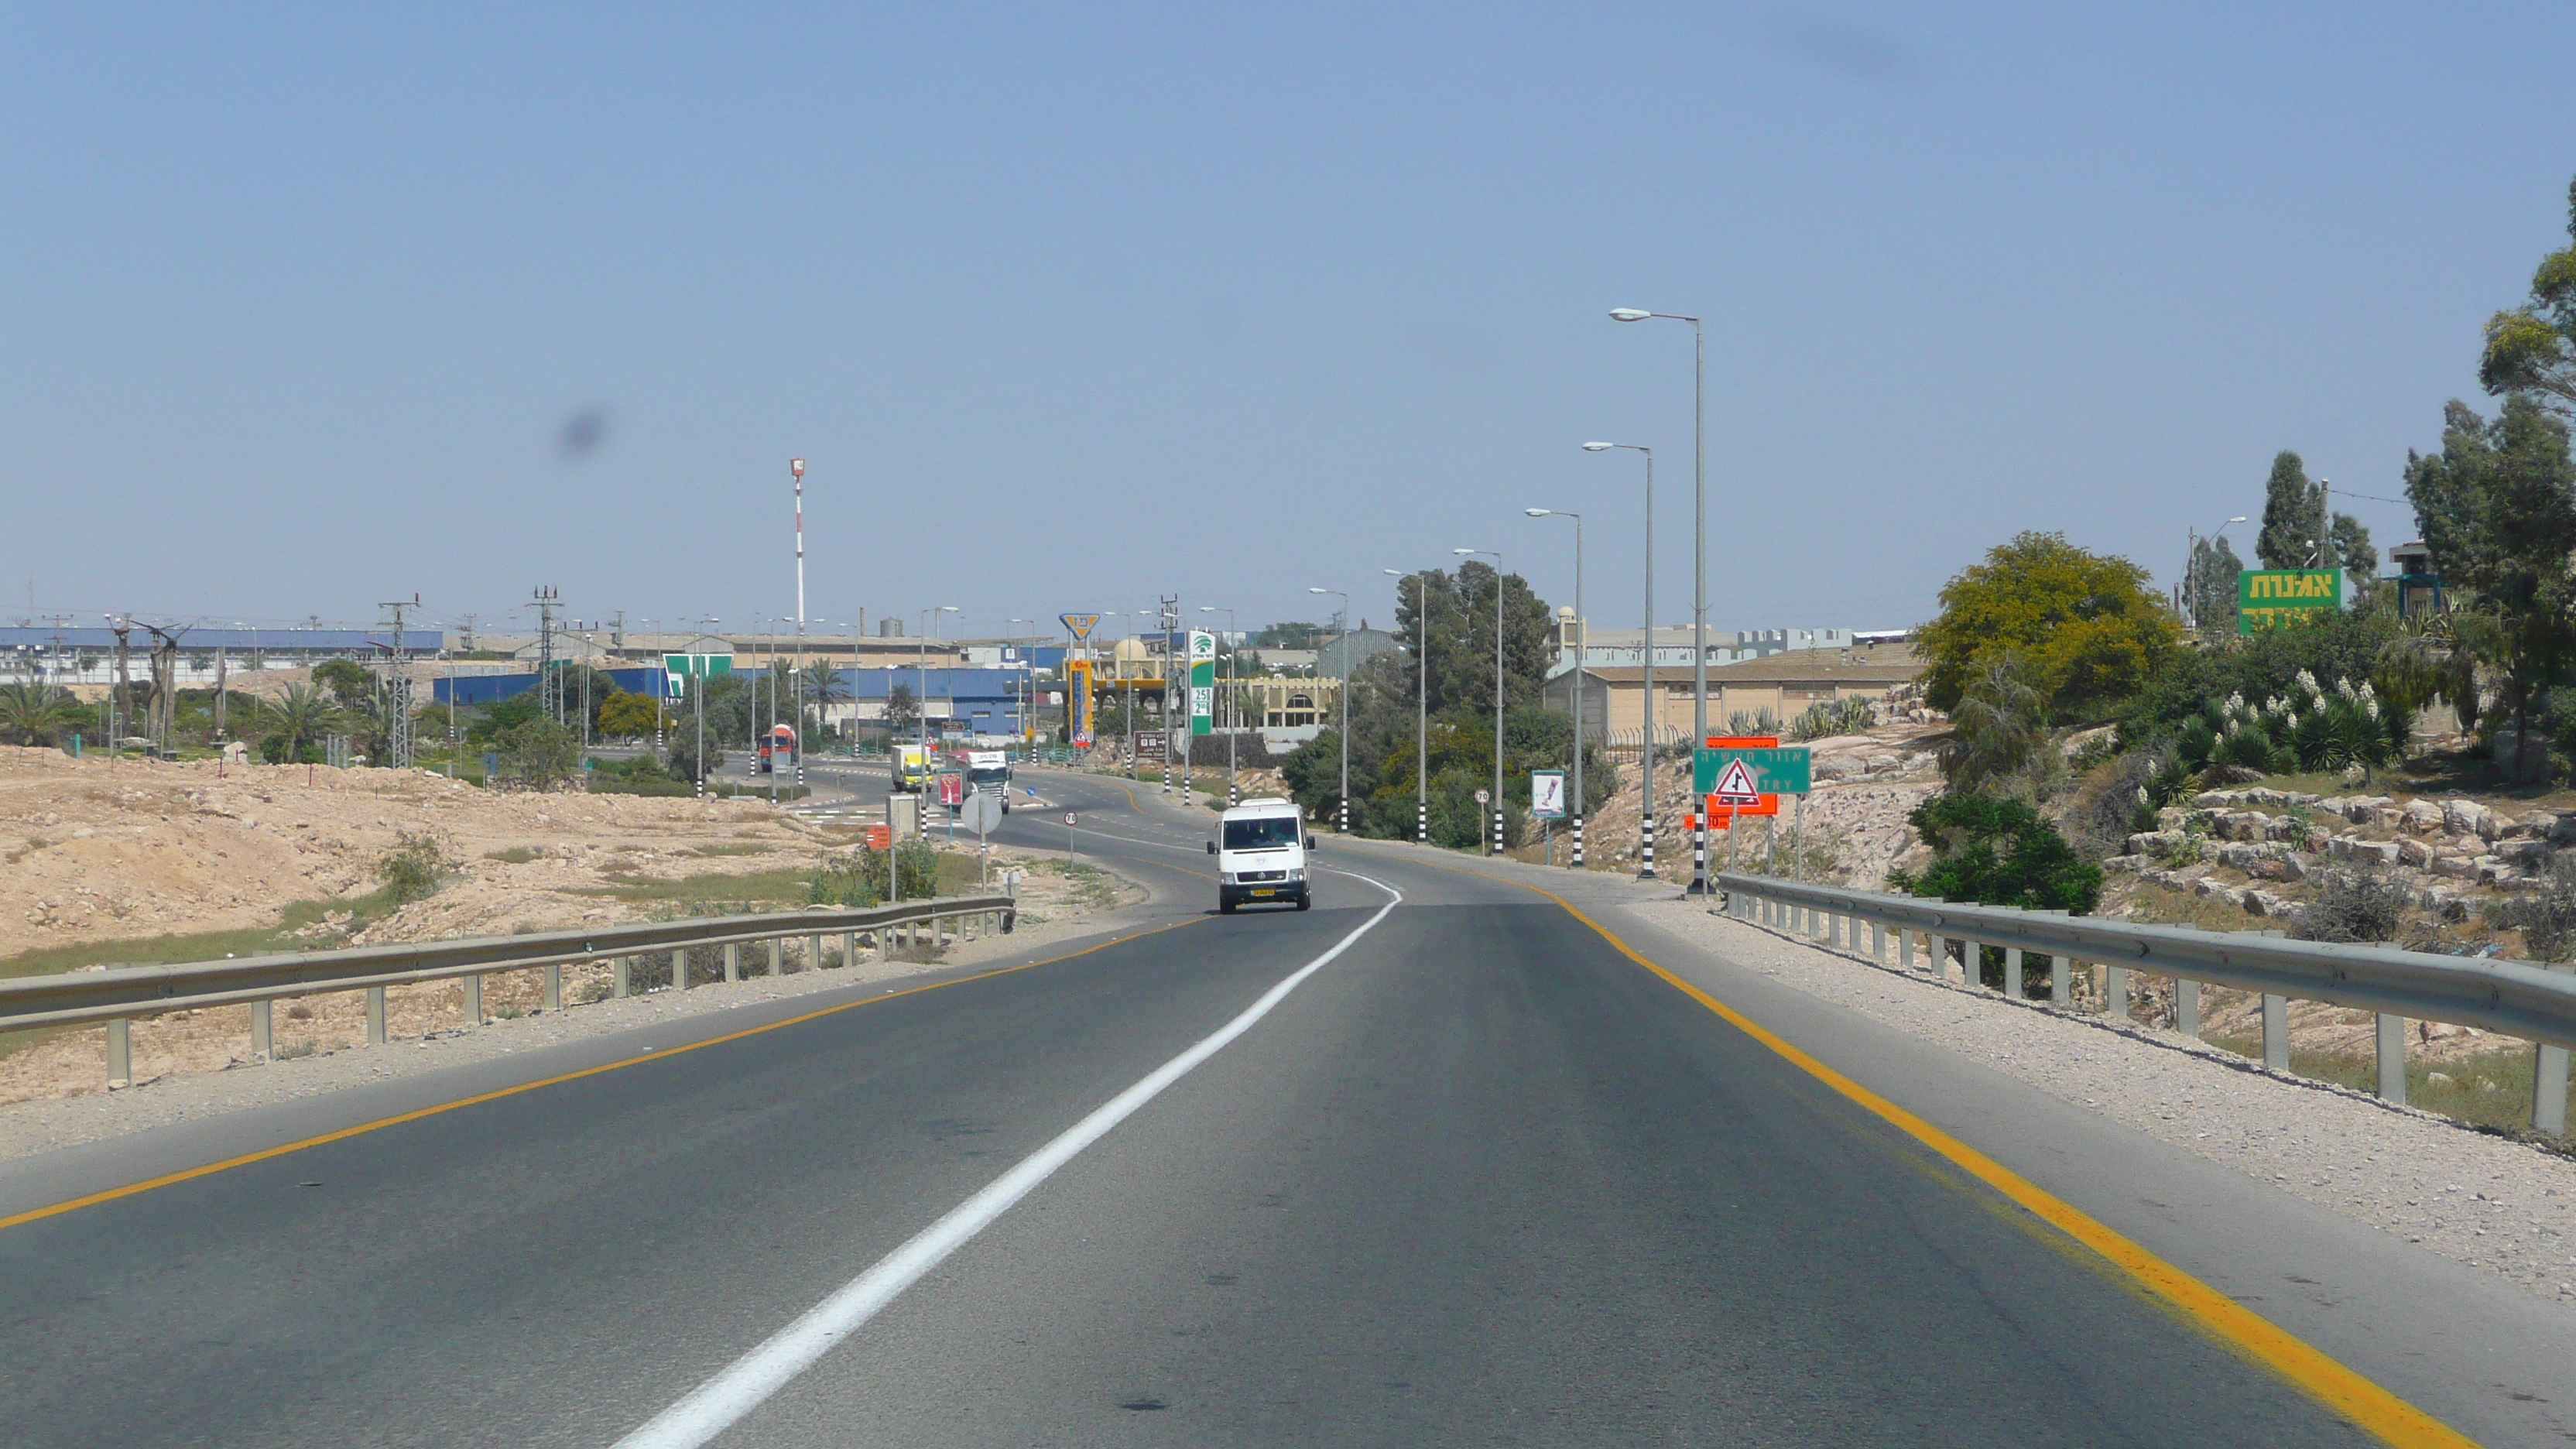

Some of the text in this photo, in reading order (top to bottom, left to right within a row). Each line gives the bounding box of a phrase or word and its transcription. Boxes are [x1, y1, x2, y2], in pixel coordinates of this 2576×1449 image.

[2249, 574, 2332, 598] אמנות
[1074, 617, 1088, 628] פז
[1766, 751, 1801, 762] אזור
